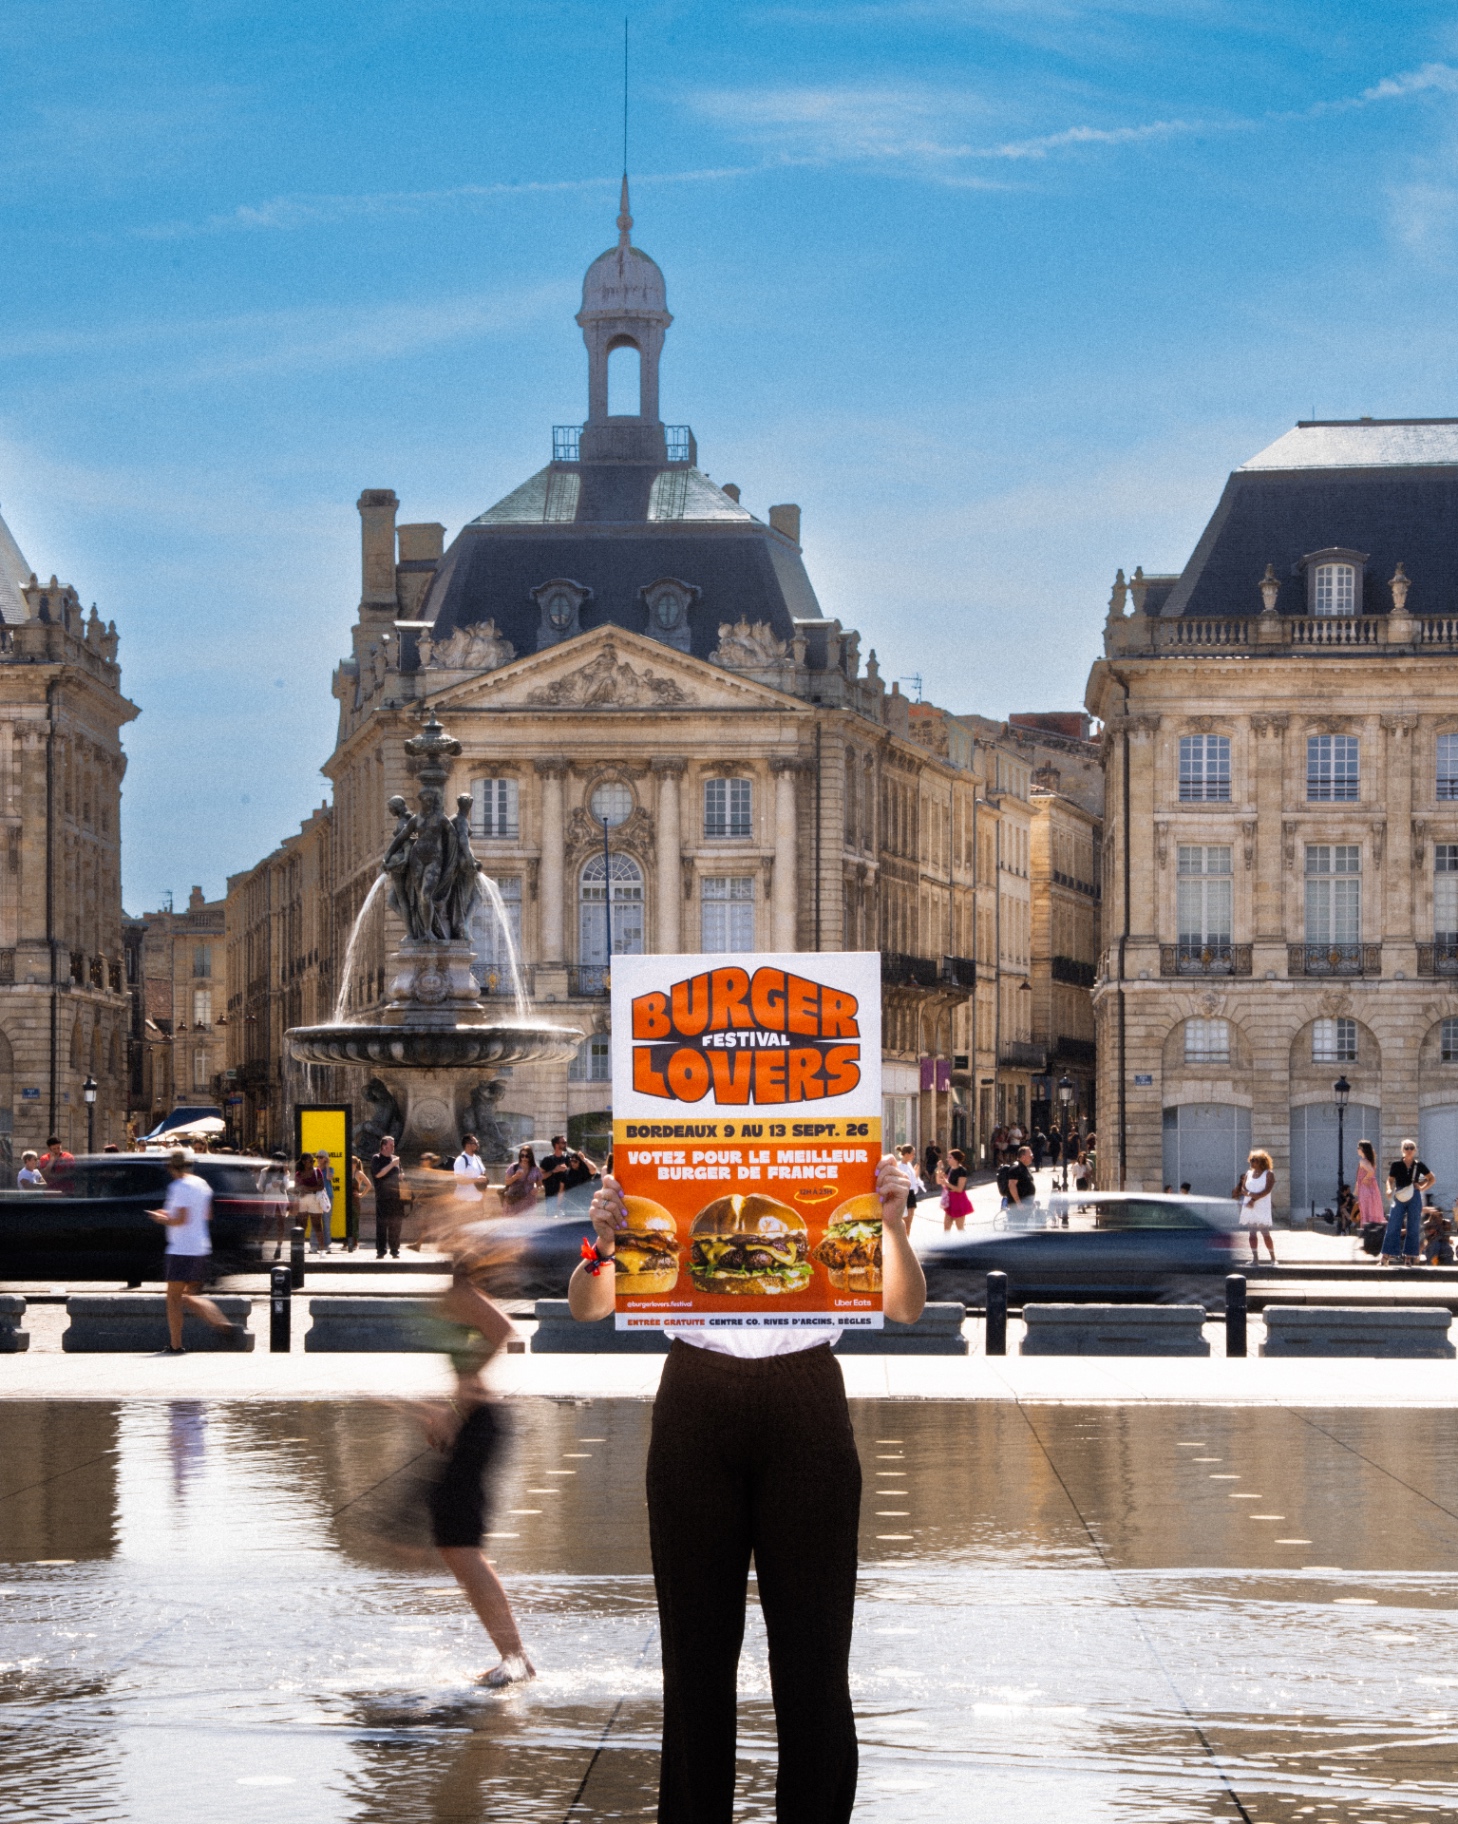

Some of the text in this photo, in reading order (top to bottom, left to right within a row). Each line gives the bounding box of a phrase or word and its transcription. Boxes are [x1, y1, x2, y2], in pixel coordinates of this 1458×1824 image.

[632, 966, 861, 1040] BURGER
[702, 1031, 790, 1048] FESTIVAL
[632, 1044, 861, 1105] LOVERS
[626, 1123, 869, 1138] BORDEAUX 9 AU 13 SEPT. 26
[627, 1149, 868, 1165] VOTEZ POUR LE MEILLEUR
[657, 1165, 838, 1180] BURGER DE FRANCE
[854, 1298, 871, 1306] Eats
[627, 1317, 661, 1325] ENTRÉE
[792, 1318, 835, 1326] D'ARCINS,
